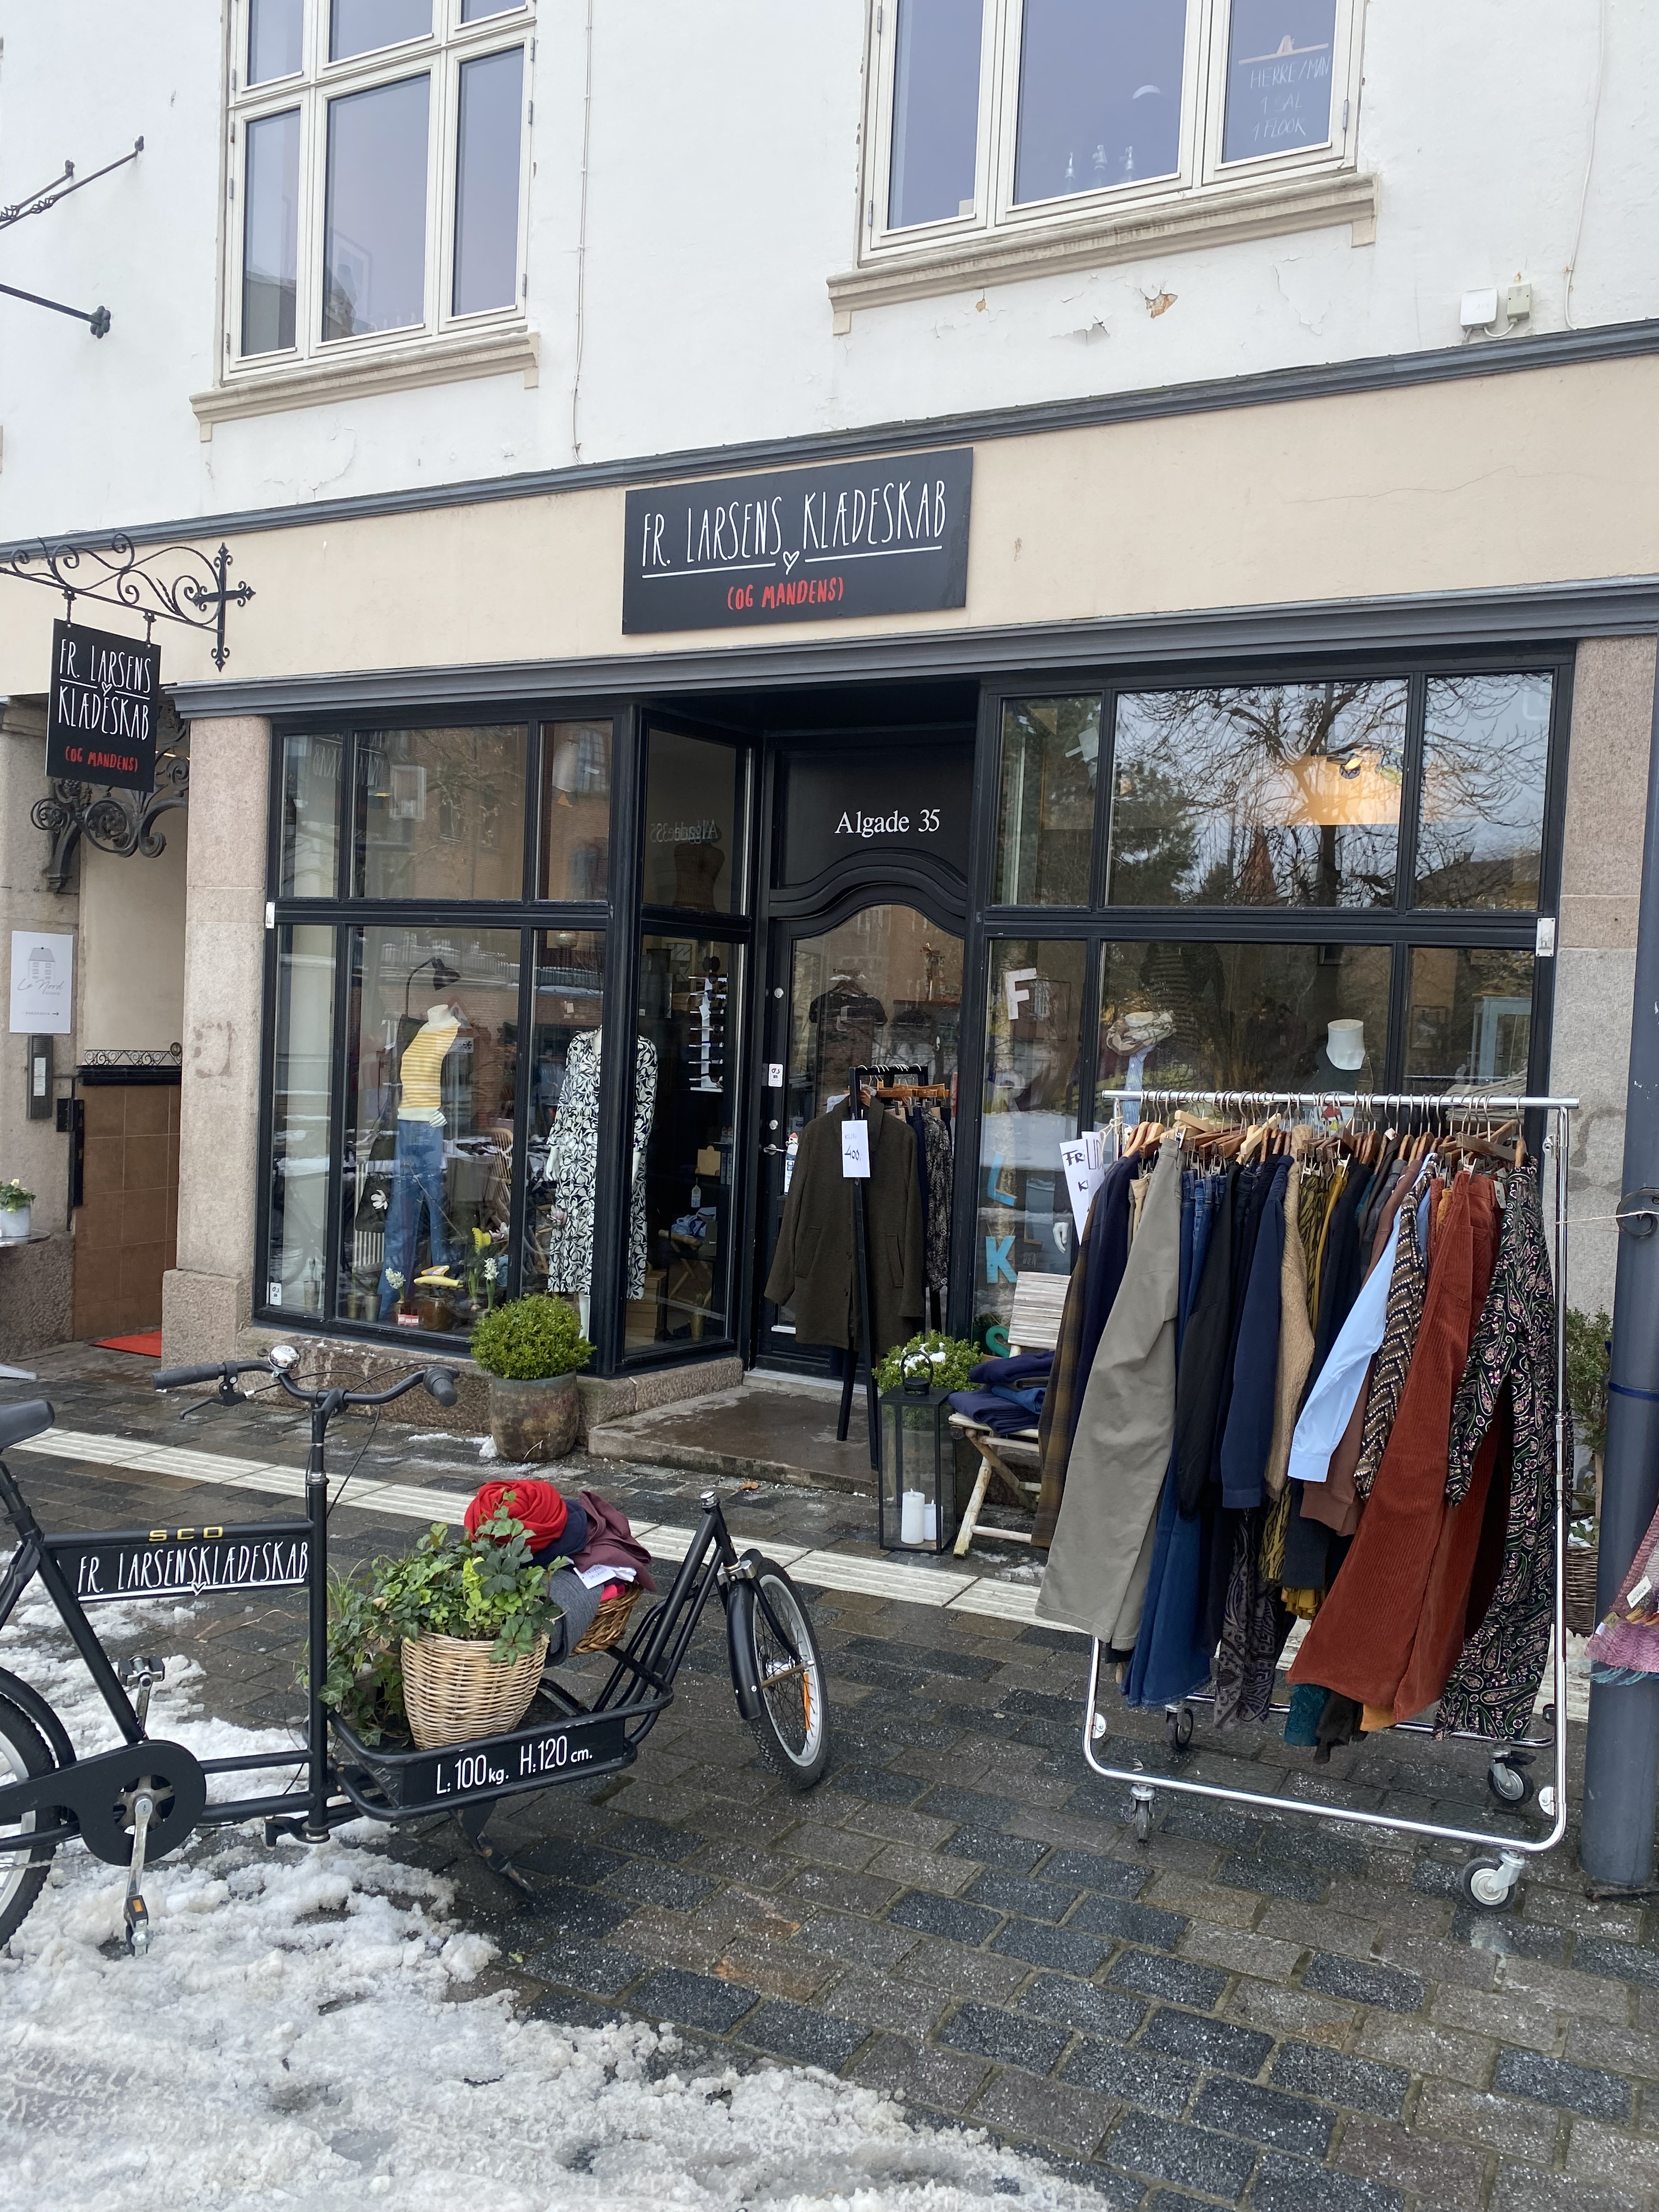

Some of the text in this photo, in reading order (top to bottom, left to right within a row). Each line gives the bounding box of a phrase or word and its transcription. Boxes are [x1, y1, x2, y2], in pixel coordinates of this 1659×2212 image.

[1261, 96, 1267, 114] 1
[1252, 121, 1260, 142] 1
[642, 480, 946, 567] FR. LARSENS KLÆDESKAB
[727, 577, 844, 611] (OG MANDENS)
[59, 639, 151, 693] FR. LARSENS
[58, 686, 149, 741] KLÆDESKAB
[65, 746, 138, 772] (OG MANDENS)
[834, 809, 941, 838] Algade 35
[149, 1527, 223, 1542] SCO
[78, 1556, 104, 1593] FR.
